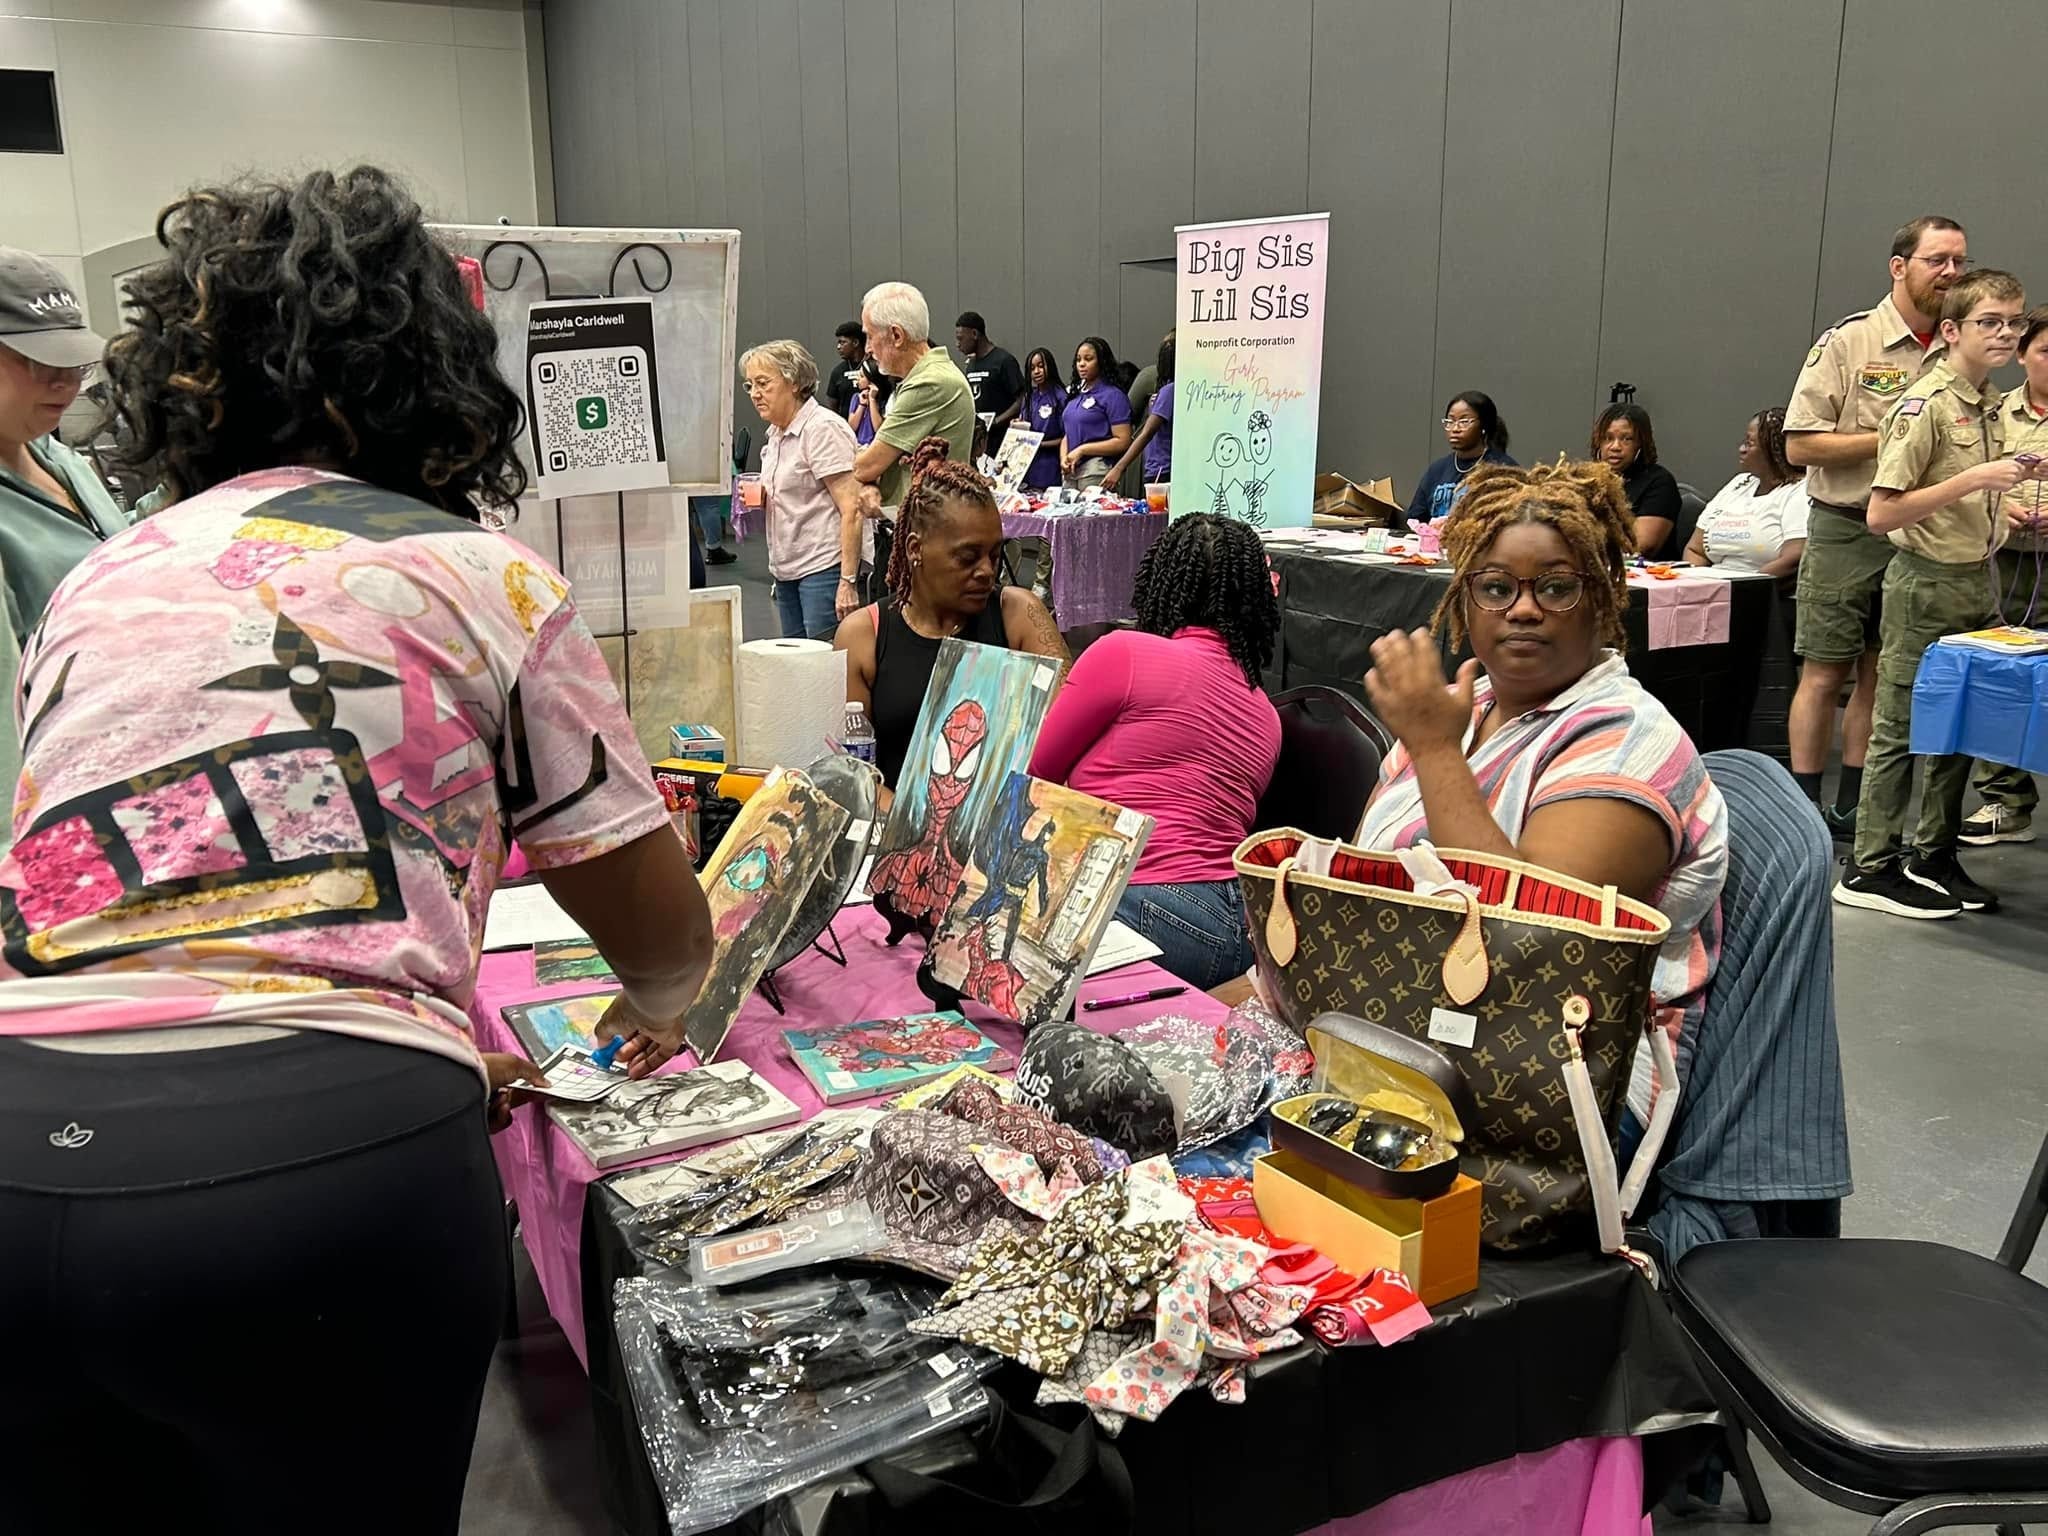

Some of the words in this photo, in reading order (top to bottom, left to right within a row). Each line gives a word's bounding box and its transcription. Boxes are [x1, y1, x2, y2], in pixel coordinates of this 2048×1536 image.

[1188, 240, 1246, 281] Big
[1257, 234, 1313, 269] Sis
[1190, 288, 1237, 322] Lil
[1250, 284, 1309, 320] Sis
[1196, 337, 1239, 349] Nonprofit
[1240, 335, 1295, 347] Corporation
[1224, 353, 1259, 385] Girls
[1186, 379, 1247, 415] Mentoring
[1252, 377, 1305, 415] Program
